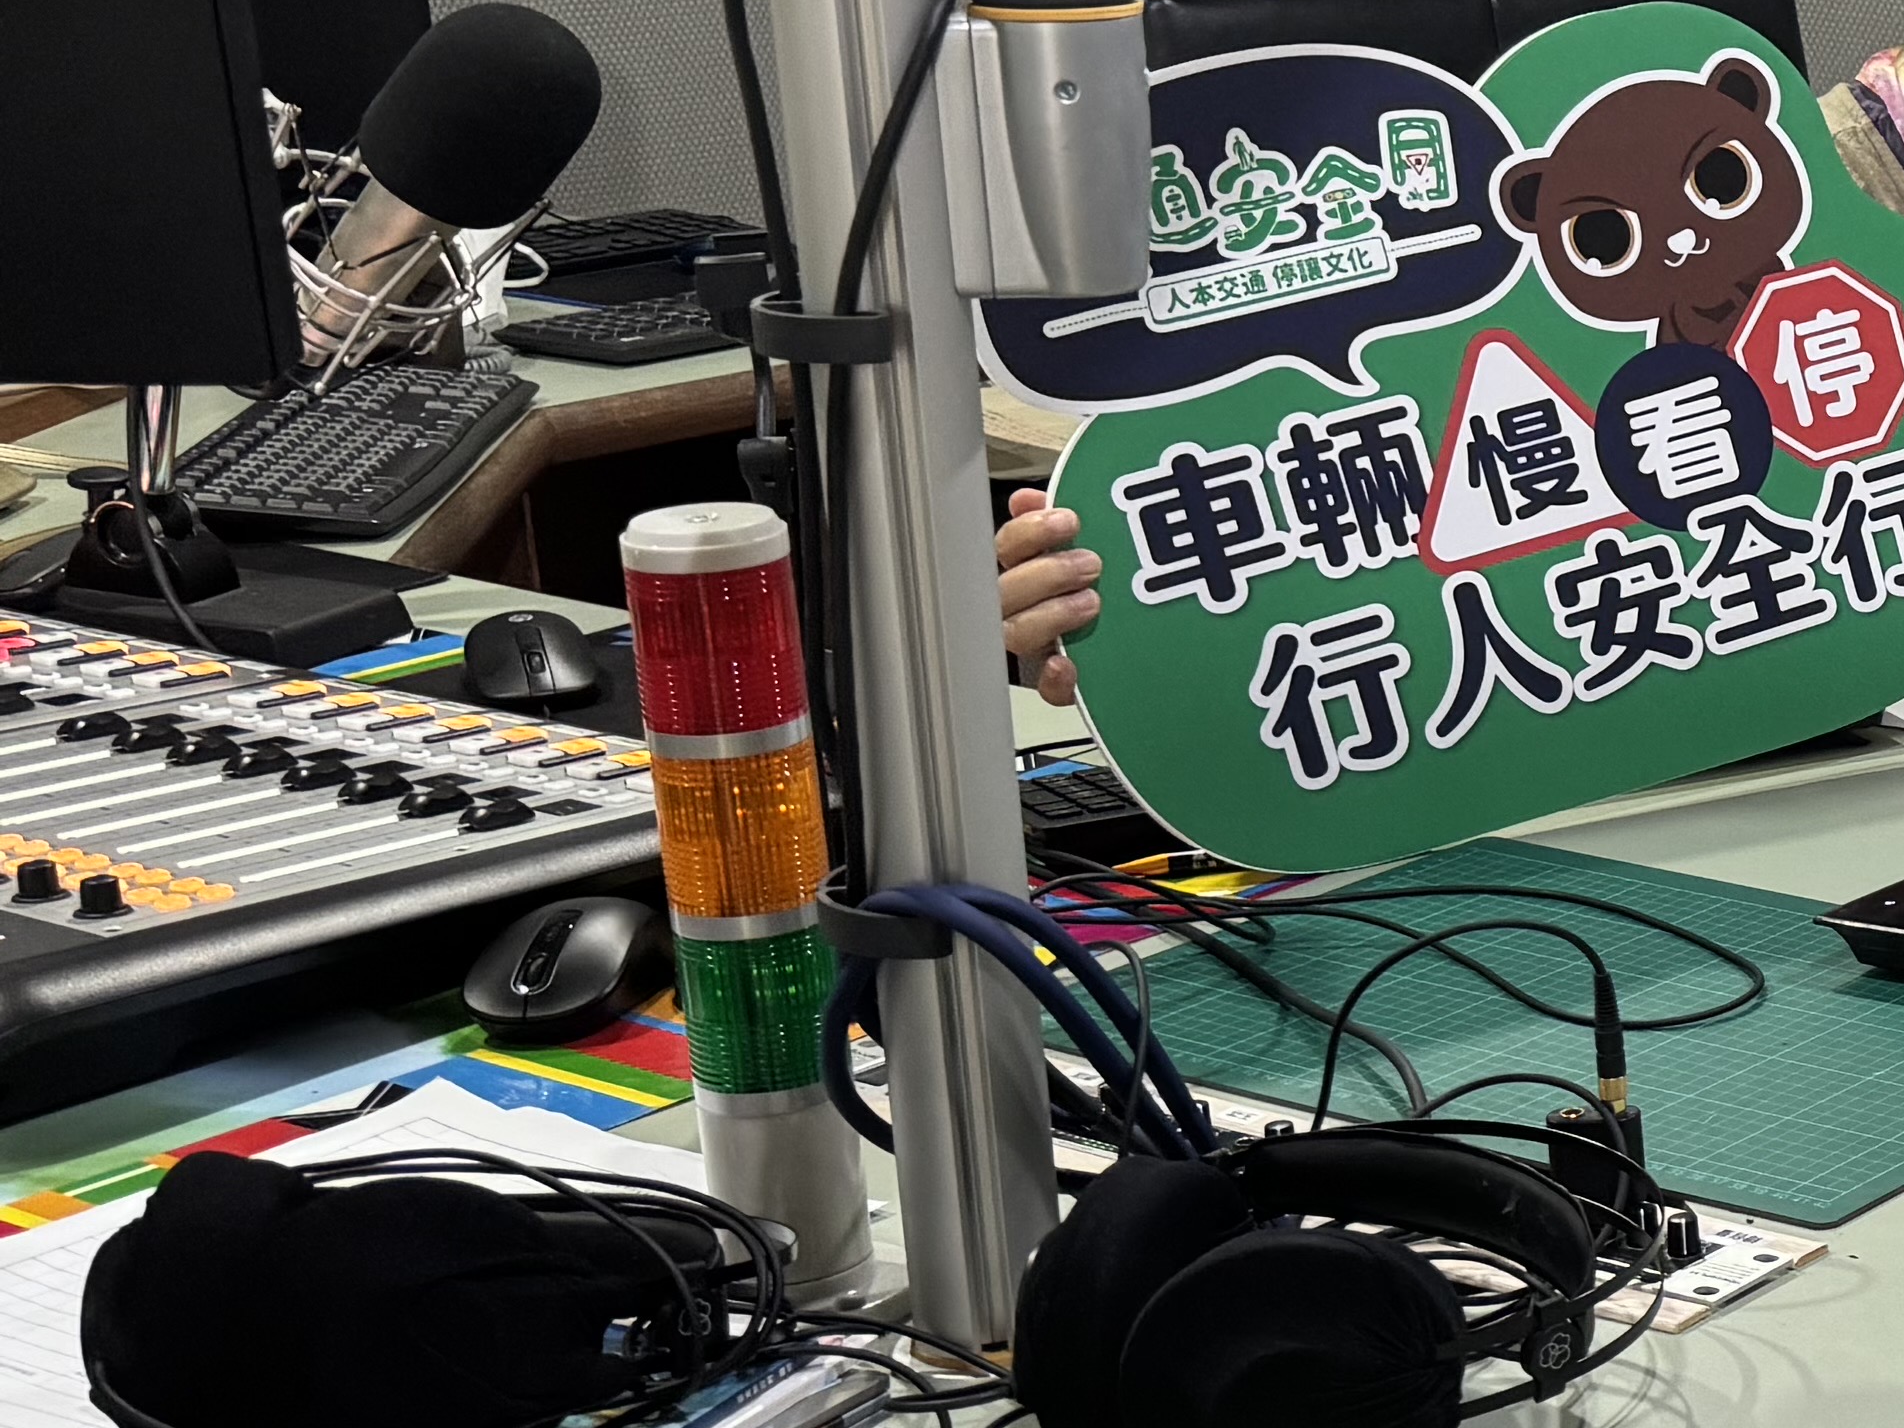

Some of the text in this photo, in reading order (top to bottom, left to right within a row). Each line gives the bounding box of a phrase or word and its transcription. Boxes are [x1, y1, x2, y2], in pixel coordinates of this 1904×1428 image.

[1167, 246, 1373, 314] 人本交通 停讓文化
